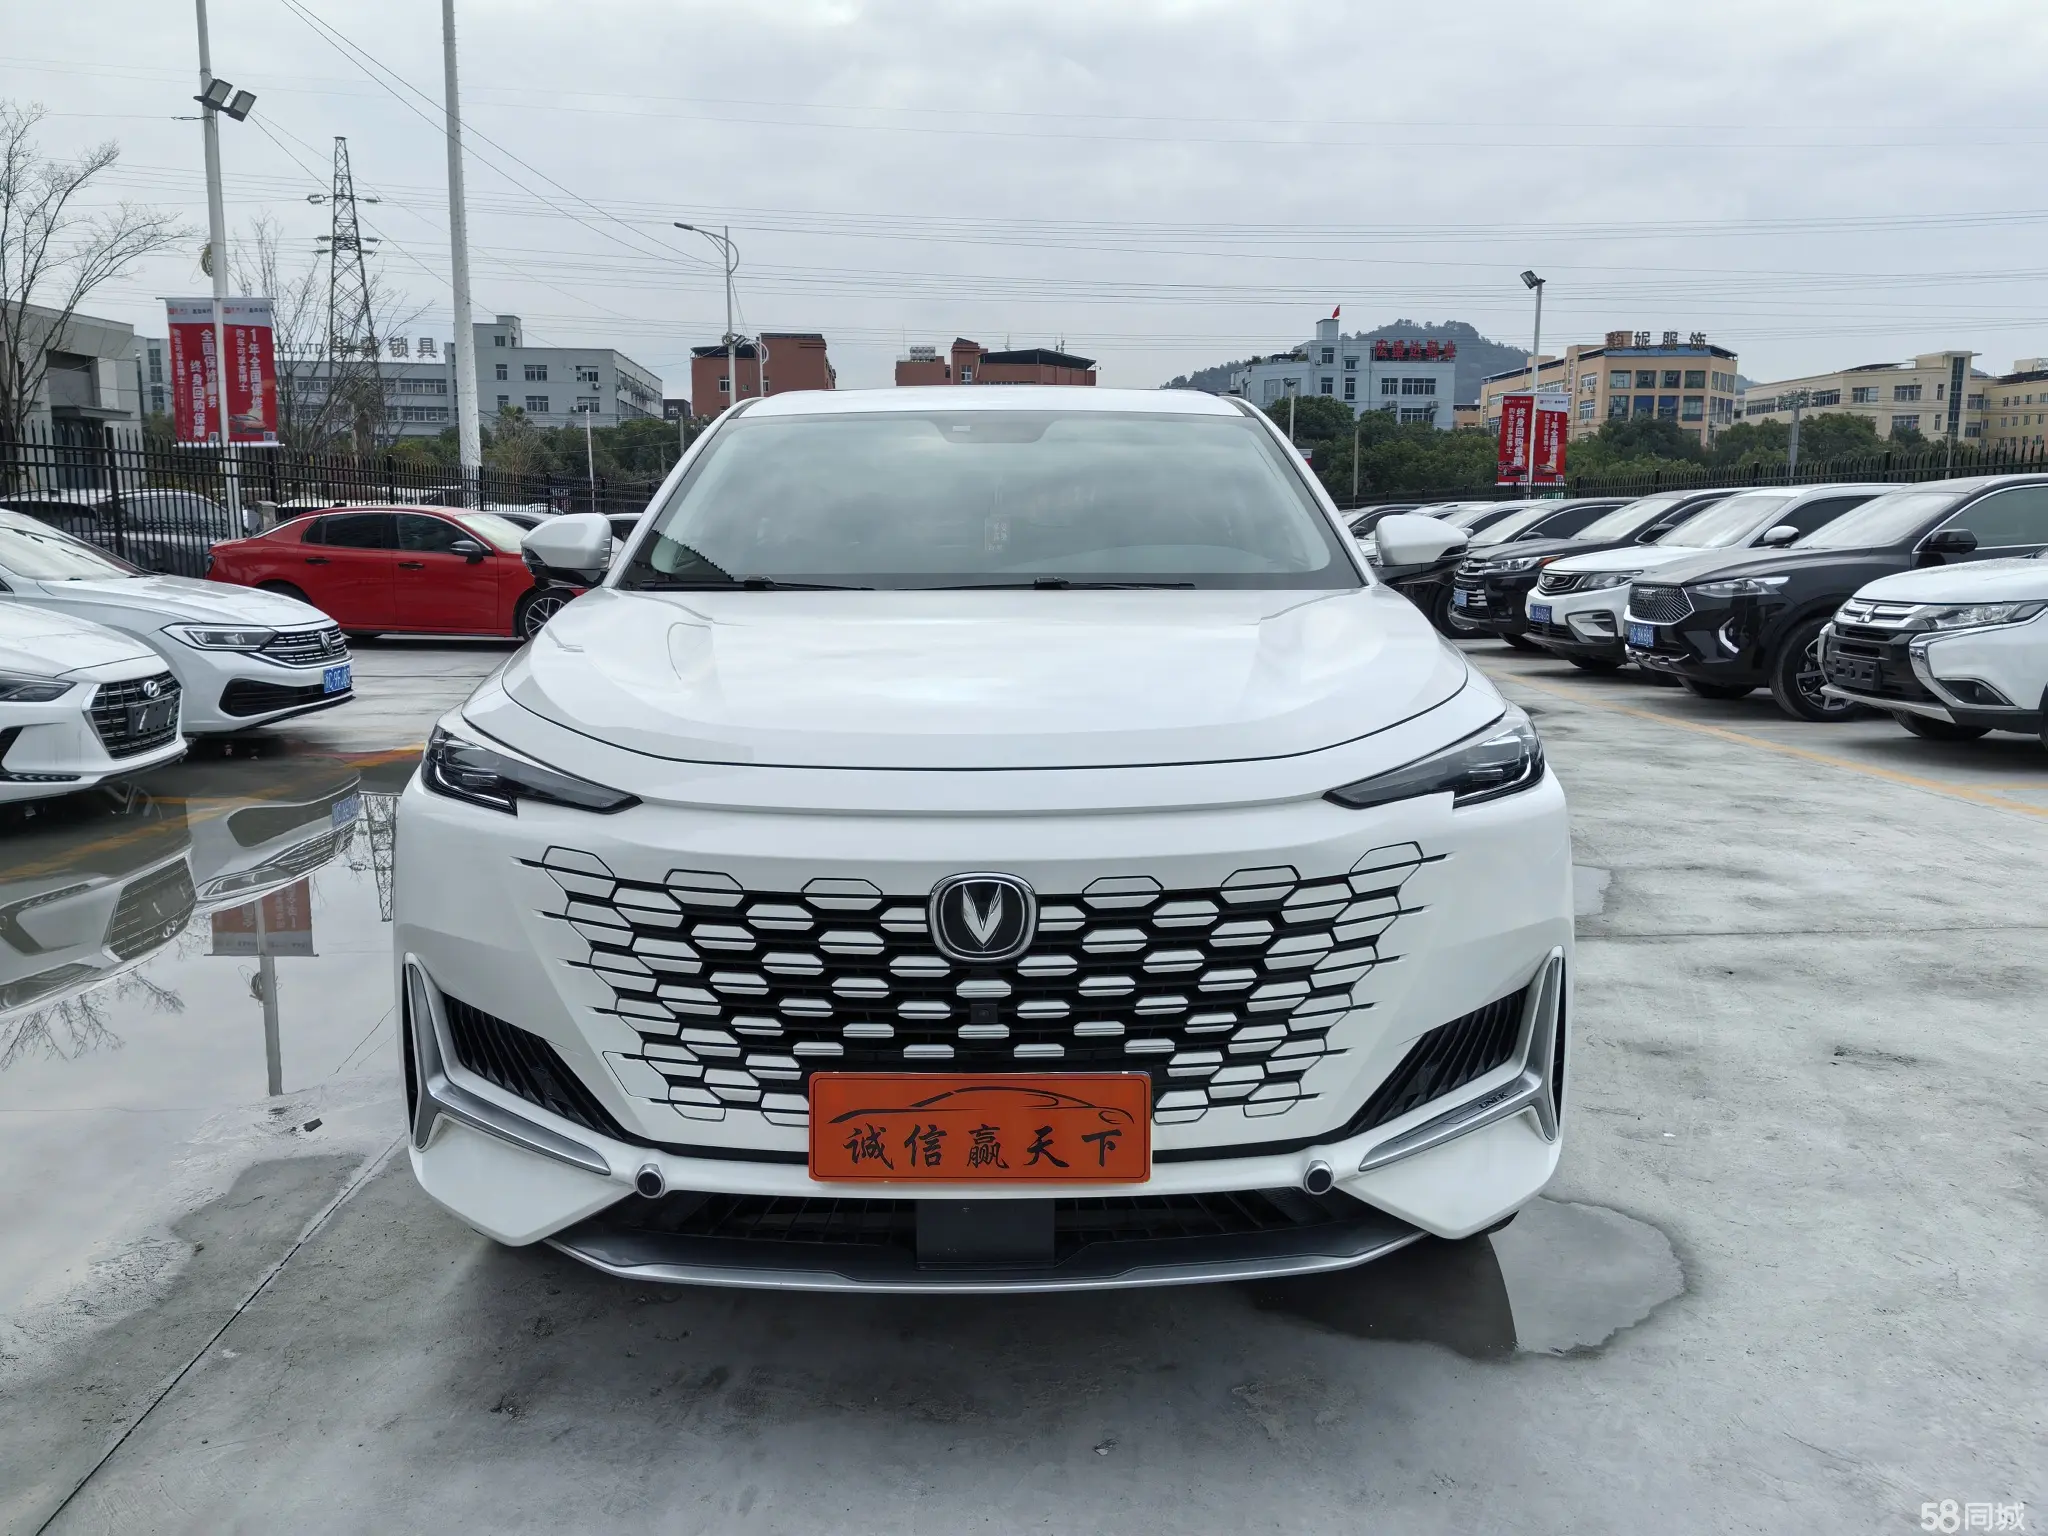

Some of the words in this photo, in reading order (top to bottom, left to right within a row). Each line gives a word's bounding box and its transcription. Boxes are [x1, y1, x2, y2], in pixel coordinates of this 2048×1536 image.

[842, 1123, 1122, 1170] 诚信赢天下
